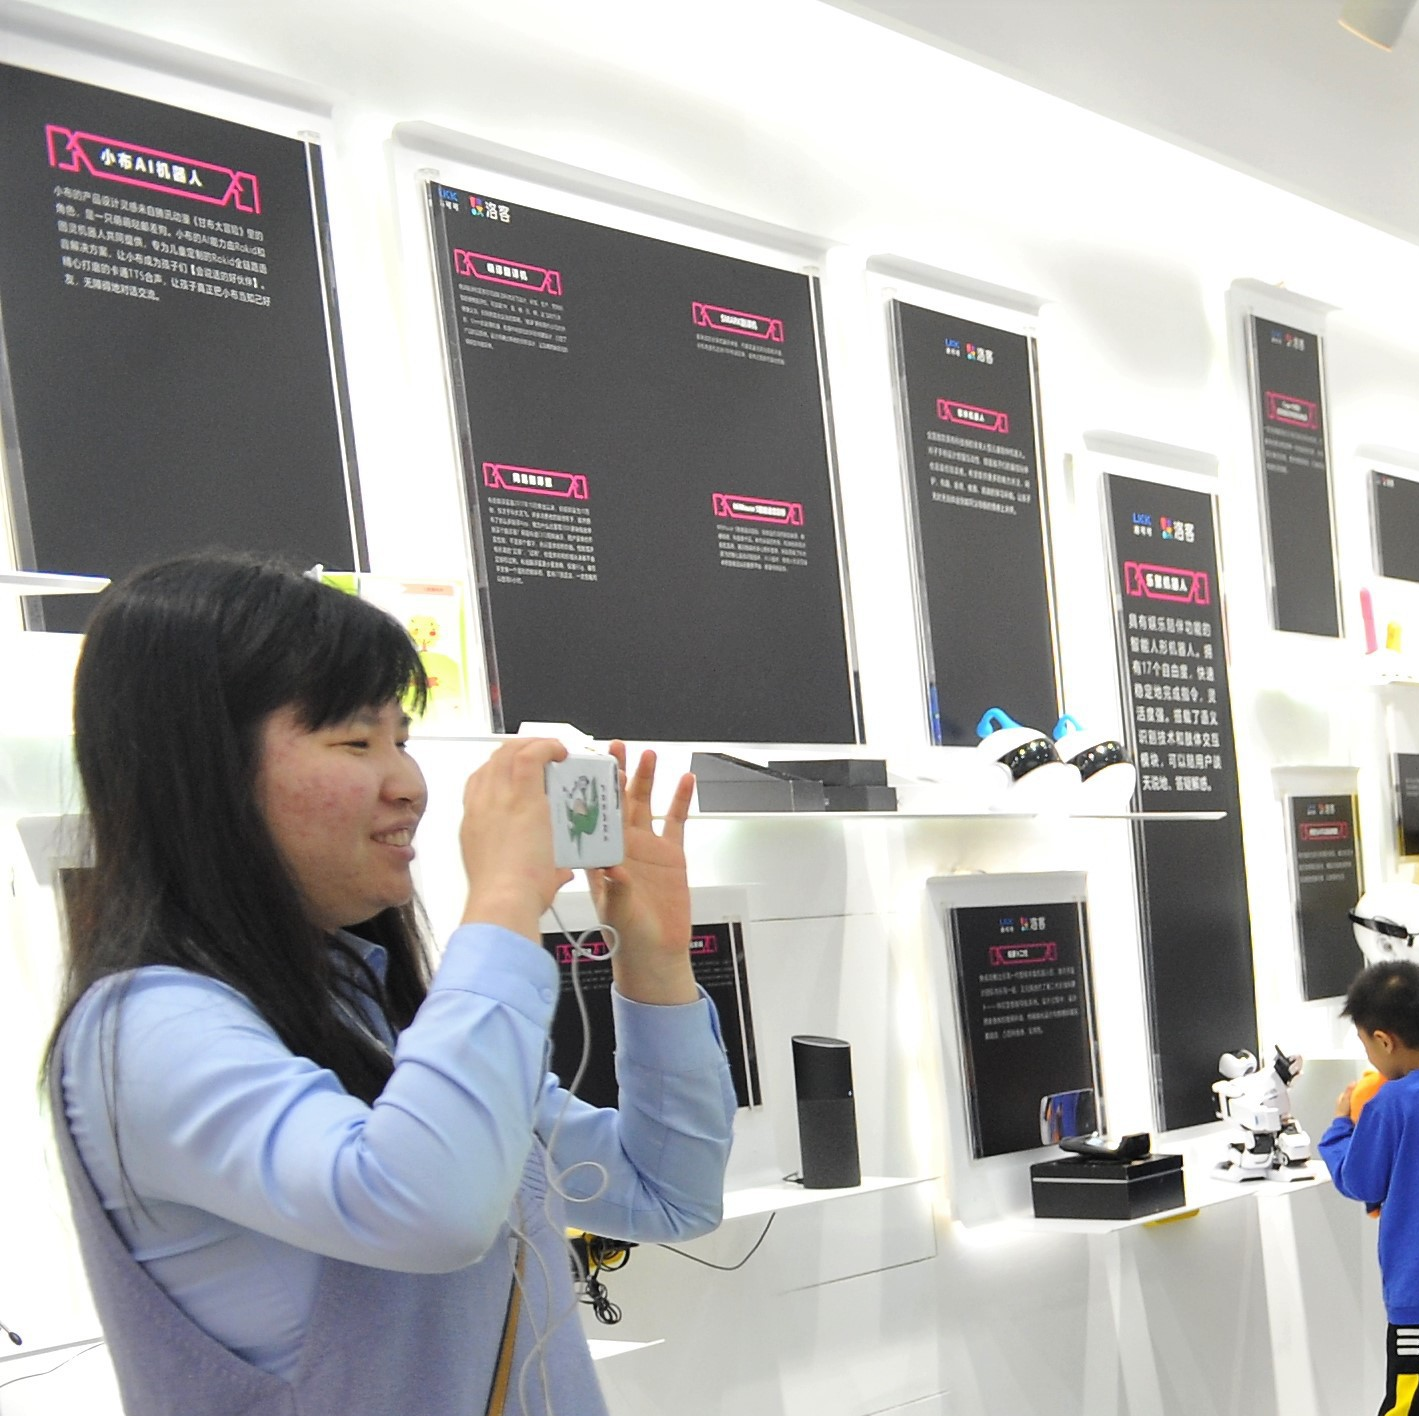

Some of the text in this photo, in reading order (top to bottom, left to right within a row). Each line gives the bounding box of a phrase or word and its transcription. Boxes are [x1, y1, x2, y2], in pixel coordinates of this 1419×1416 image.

[100, 148, 203, 187] 小布AI机器人
[485, 201, 511, 223] 洛客
